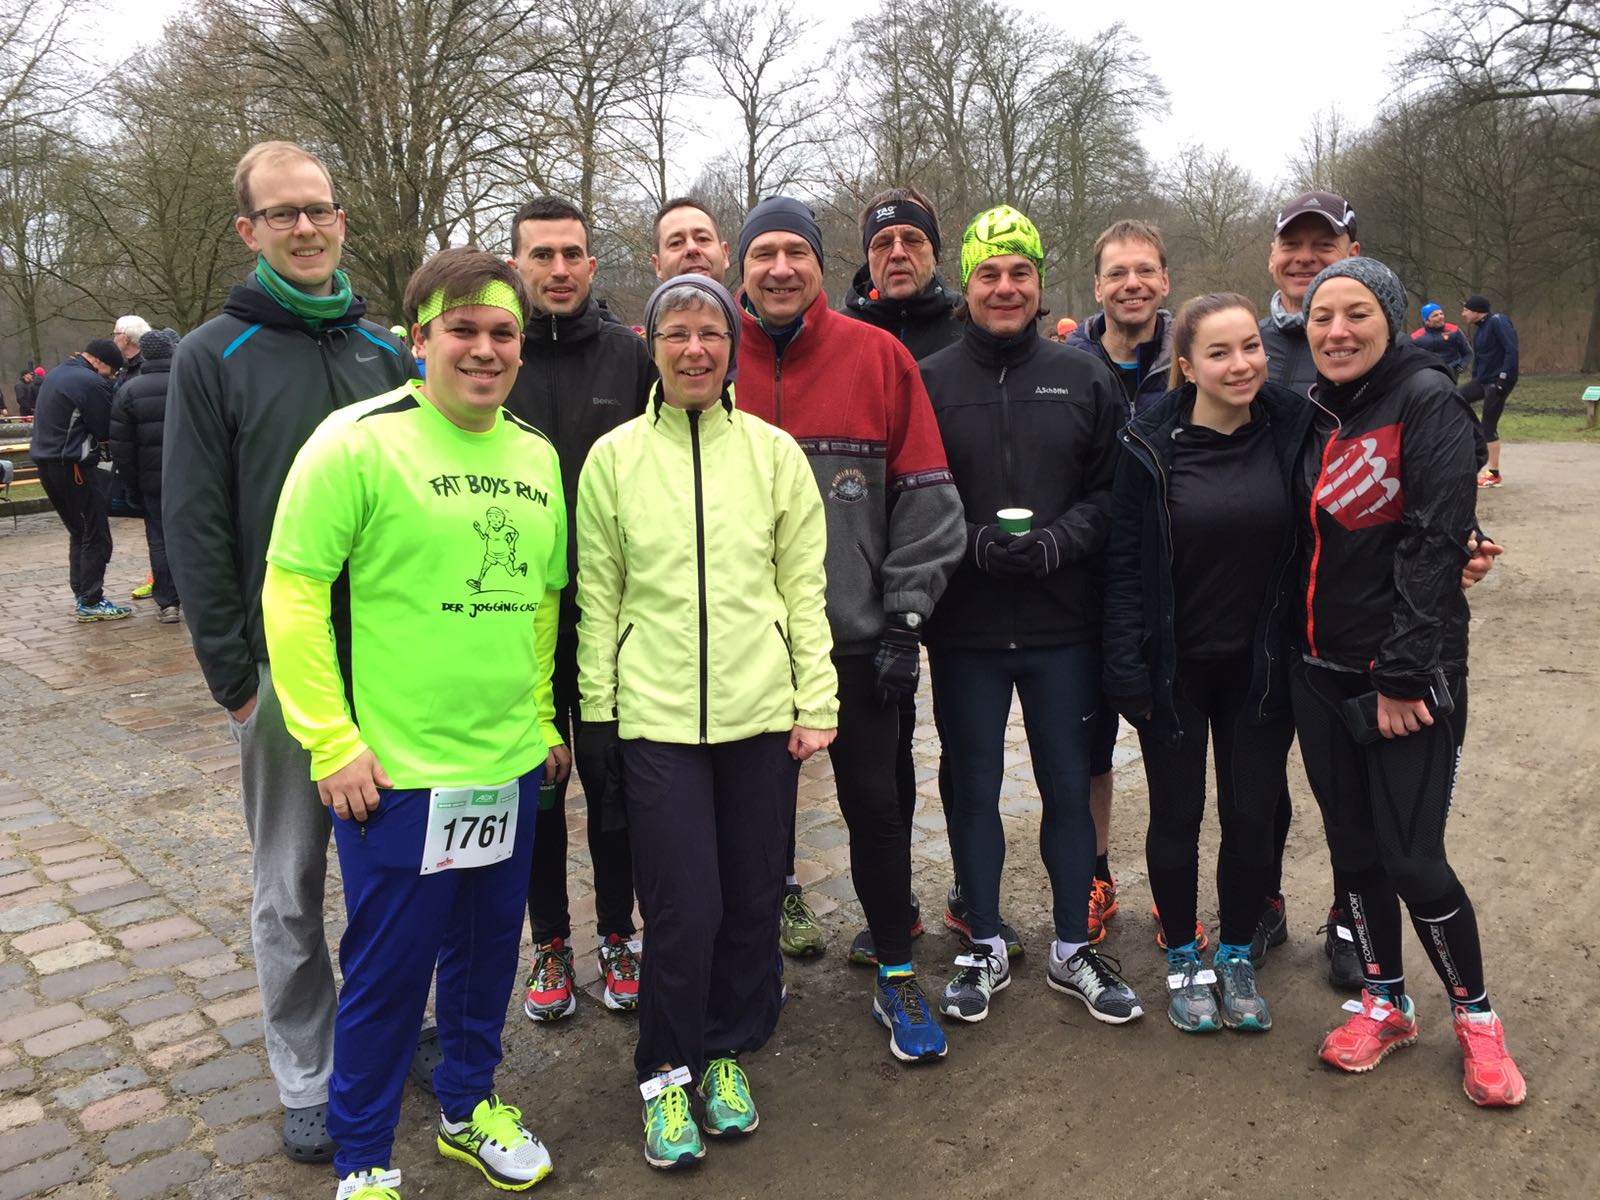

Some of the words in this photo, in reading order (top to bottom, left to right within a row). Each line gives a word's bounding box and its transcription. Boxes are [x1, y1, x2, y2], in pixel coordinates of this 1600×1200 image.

[428, 474, 461, 498] FAT
[465, 474, 510, 499] BOYS
[514, 480, 548, 507] RUN
[441, 602, 464, 613] DER
[443, 811, 509, 852] 1761
[1348, 891, 1373, 963] COMPRESSPORT
